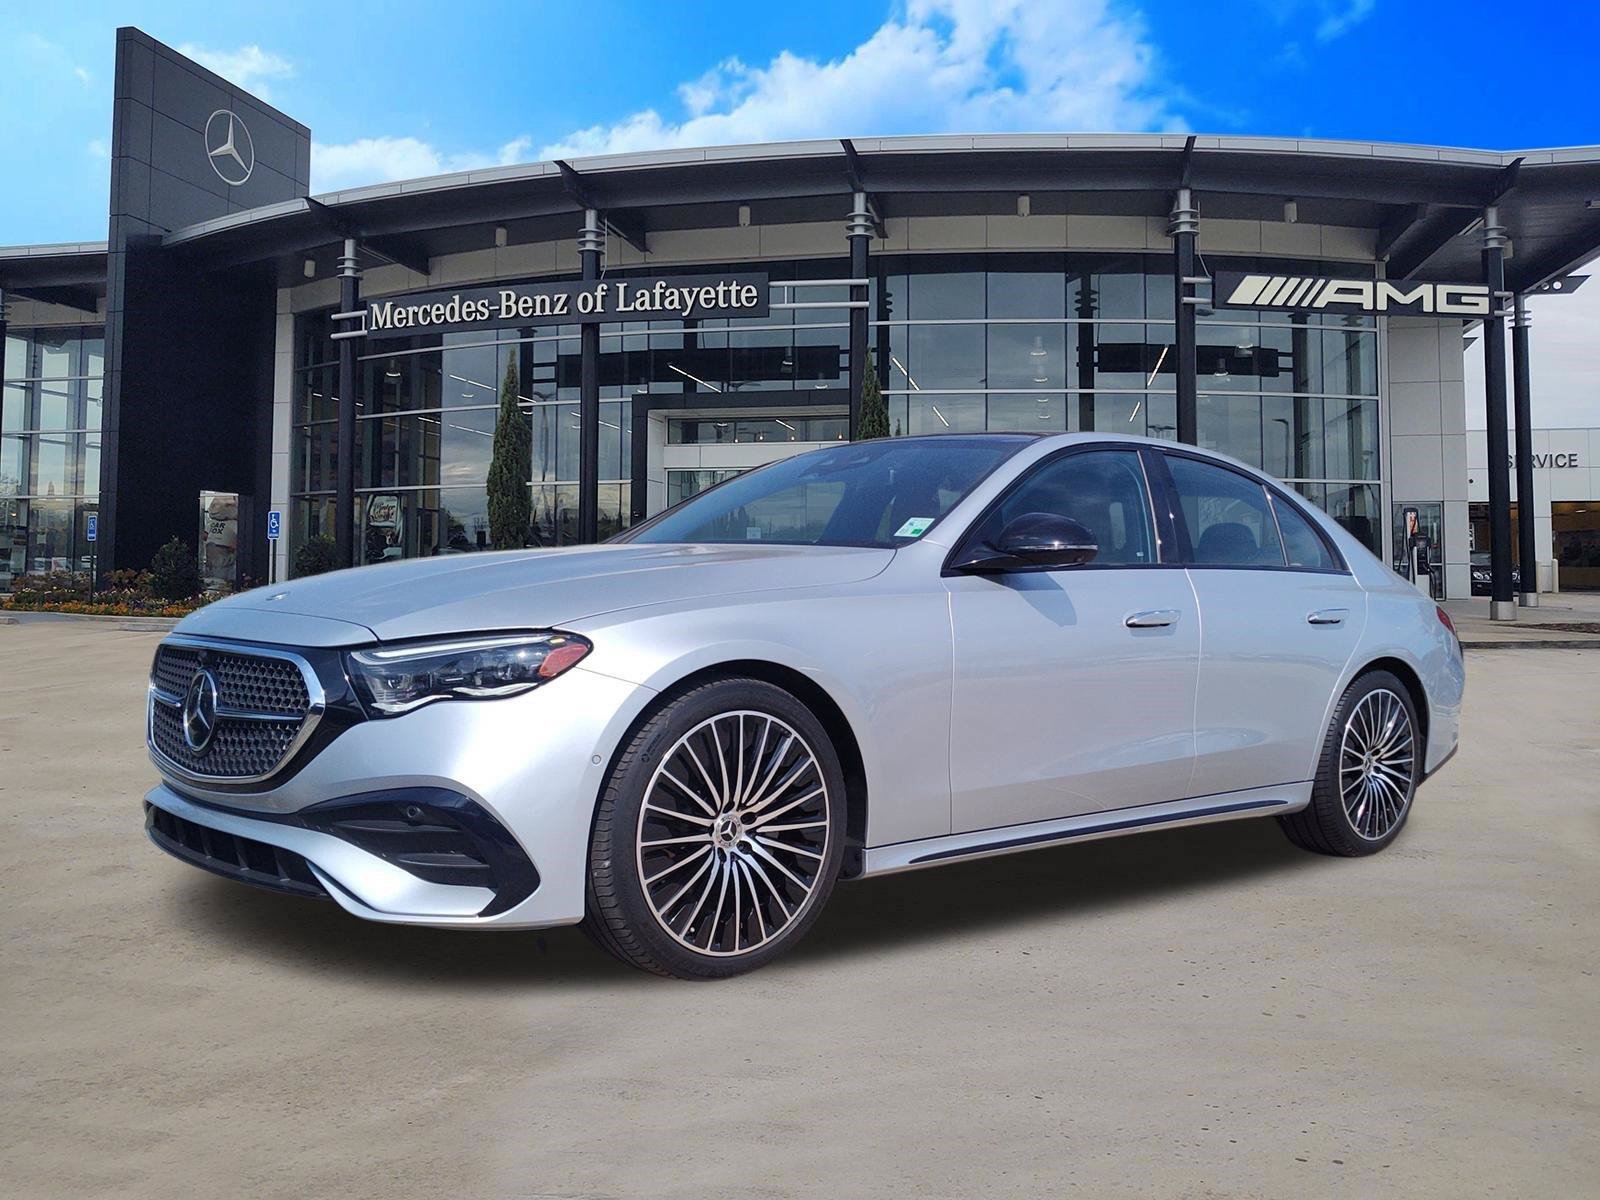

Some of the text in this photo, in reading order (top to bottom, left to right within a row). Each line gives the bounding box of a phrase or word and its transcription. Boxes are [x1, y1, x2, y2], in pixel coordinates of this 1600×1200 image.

[370, 280, 758, 330] Mercedes-Benz of Lafayette
[1507, 453, 1578, 468] SRVICE
